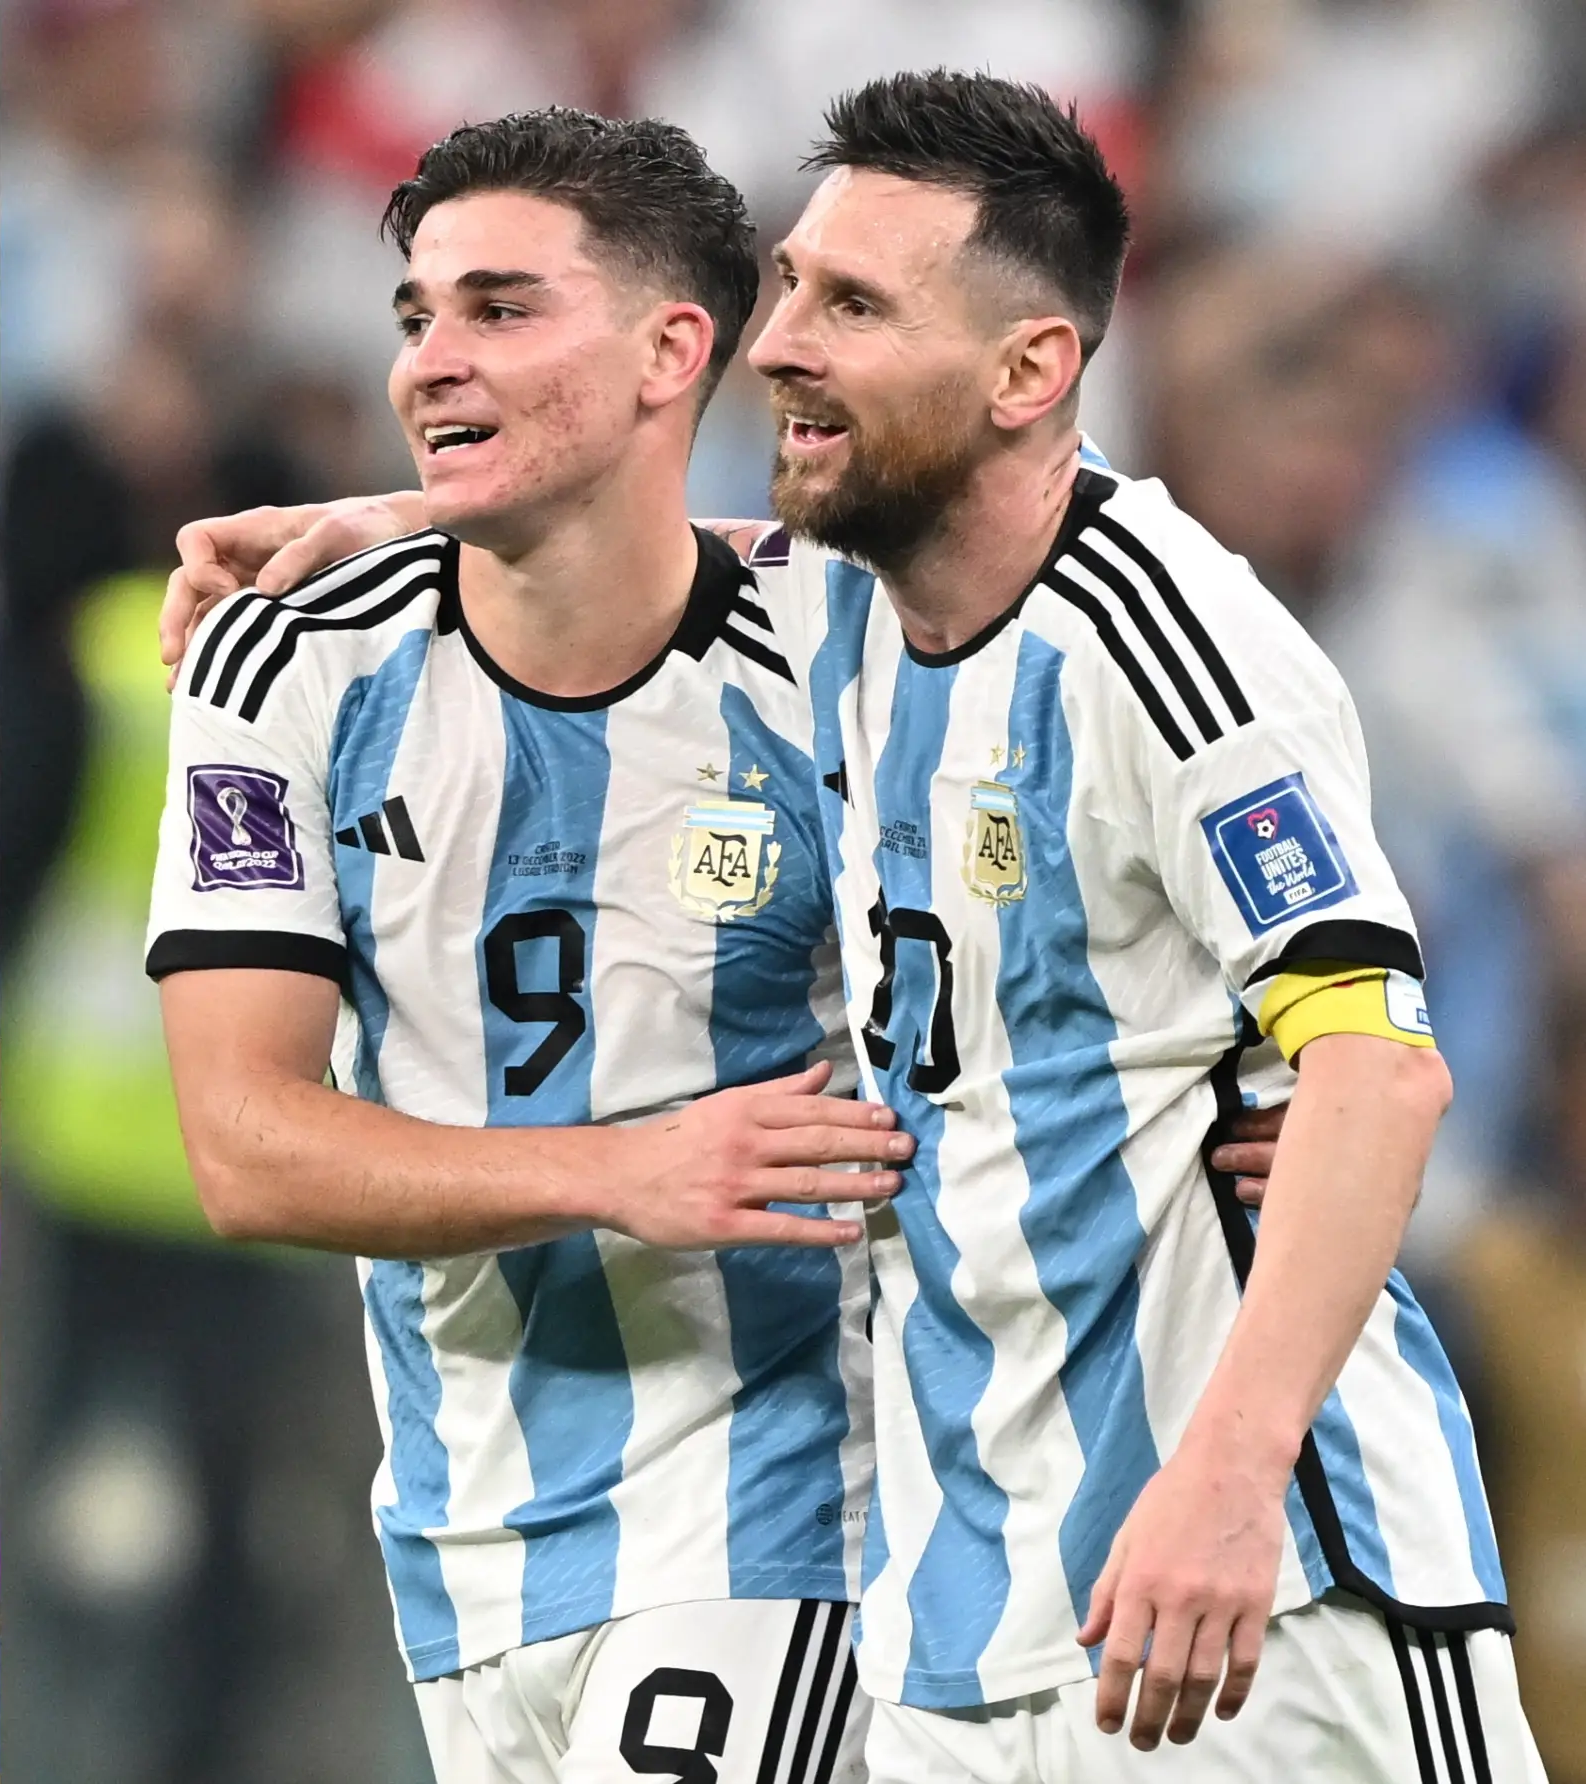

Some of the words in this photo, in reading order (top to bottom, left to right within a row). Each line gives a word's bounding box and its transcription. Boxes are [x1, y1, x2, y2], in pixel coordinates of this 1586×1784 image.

[508, 855, 519, 865] 13
[559, 851, 587, 864] 2022
[693, 831, 751, 887] AFA
[978, 812, 1017, 871] AFA
[1254, 836, 1301, 866] FOOTBALL
[1261, 847, 1308, 881] UNITES
[1266, 878, 1286, 896] the
[1282, 860, 1317, 887] World
[1288, 887, 1309, 901] FIFA
[484, 908, 586, 1097] 9
[619, 1667, 735, 1784] 9
